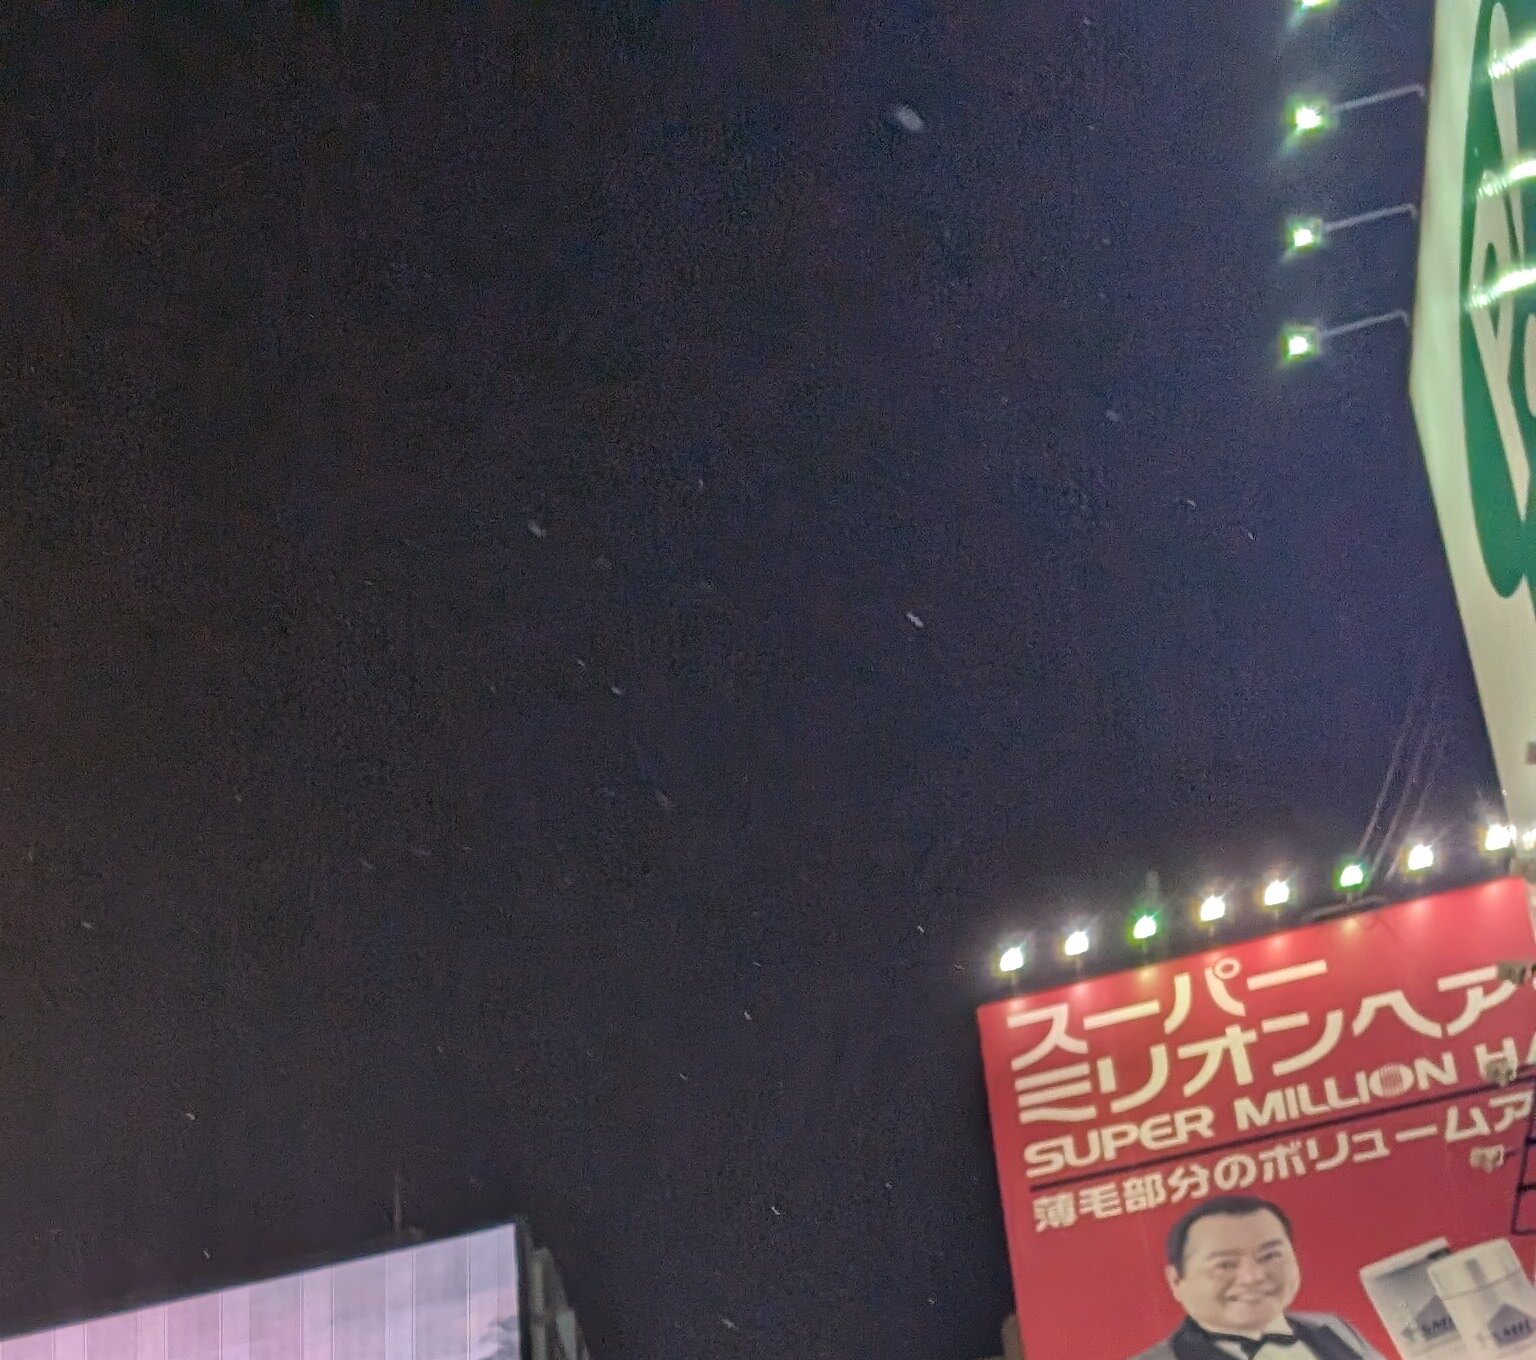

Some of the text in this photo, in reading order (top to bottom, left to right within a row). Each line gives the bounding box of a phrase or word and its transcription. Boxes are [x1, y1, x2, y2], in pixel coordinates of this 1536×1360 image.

[1009, 958, 1327, 1069] スーパー
[1025, 1106, 1214, 1178] SUPER
[1236, 1056, 1457, 1130] MILLION
